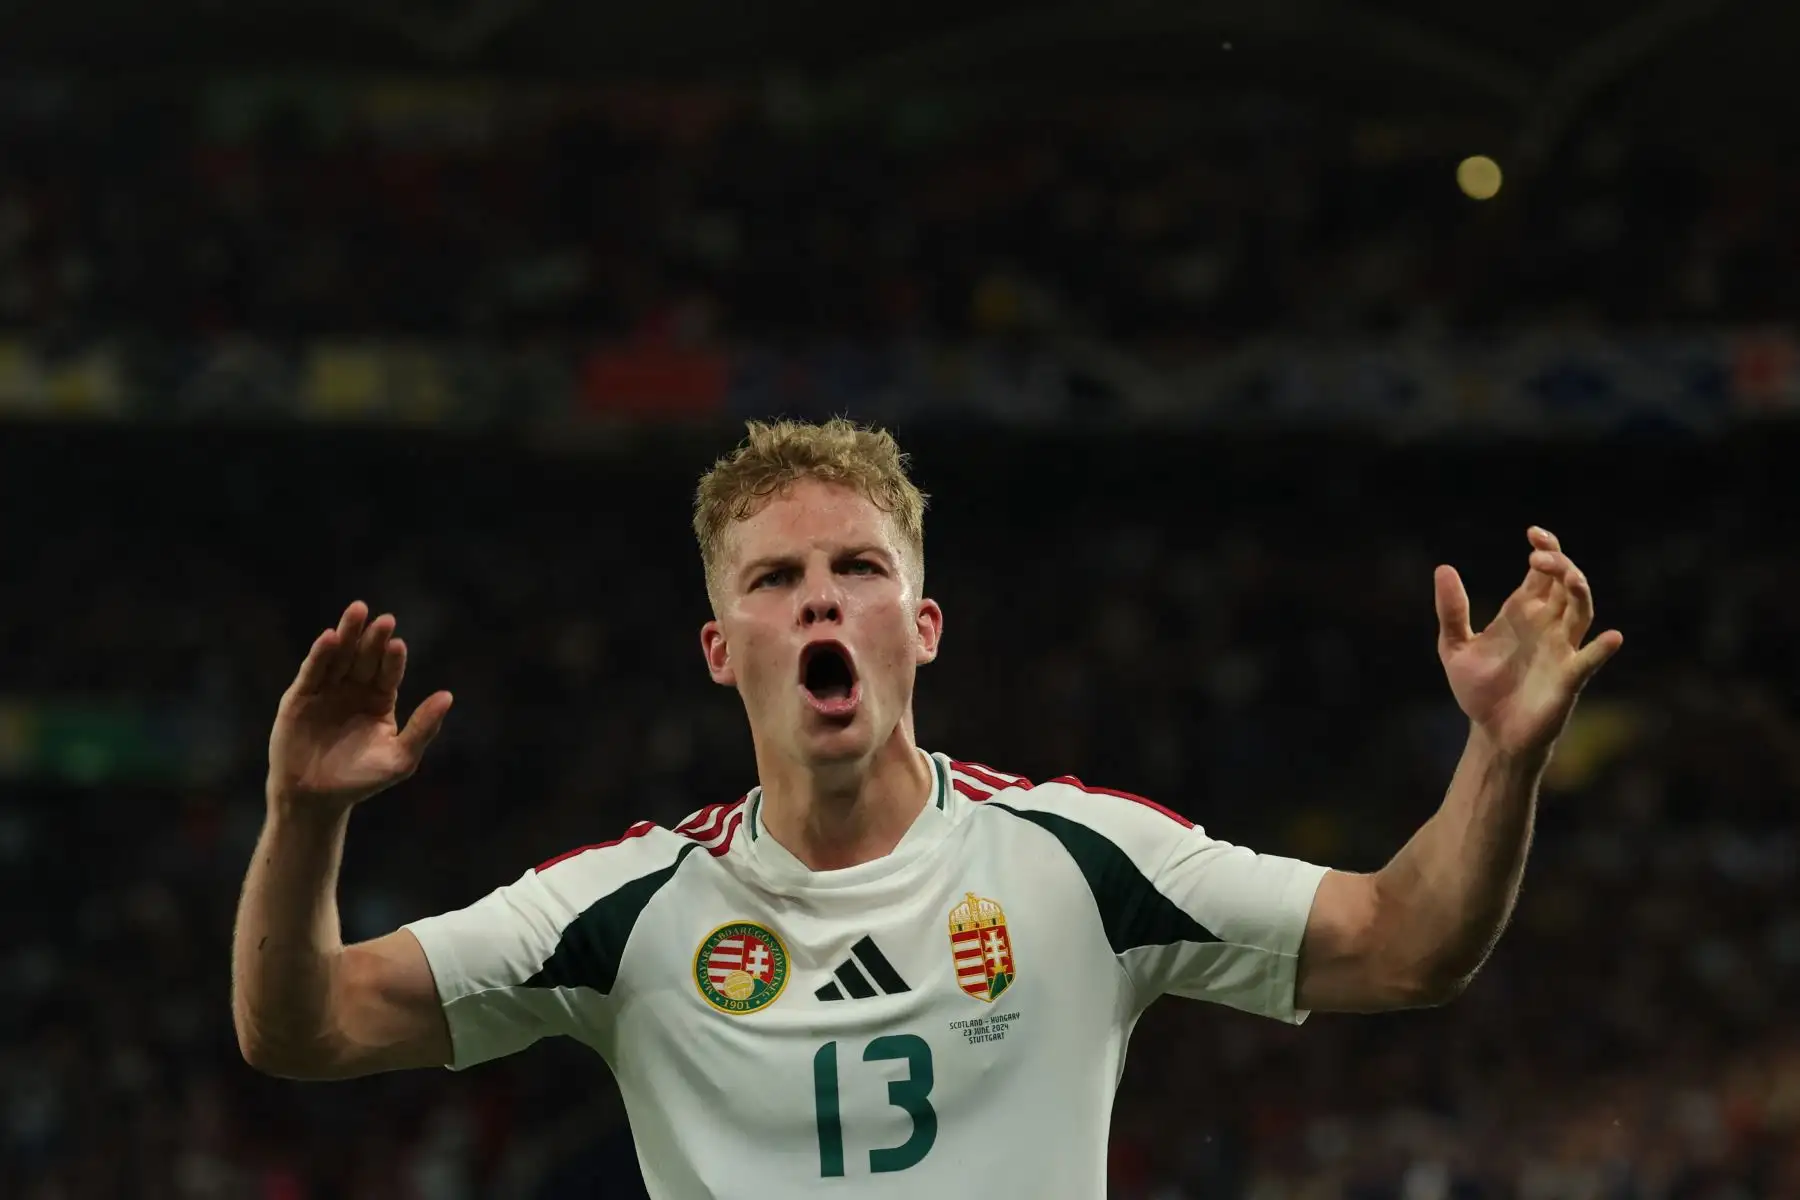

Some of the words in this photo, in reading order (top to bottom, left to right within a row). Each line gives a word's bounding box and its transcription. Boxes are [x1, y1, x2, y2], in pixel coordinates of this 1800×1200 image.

[723, 1000, 751, 1010] 1901
[949, 1019, 983, 1029] SCOTLAND
[990, 1012, 1020, 1023] HUNGARY
[974, 1026, 990, 1035] JUNE
[992, 1024, 1009, 1032] 2024
[968, 1032, 1005, 1044] STUTTGART
[813, 1033, 938, 1177] 13
